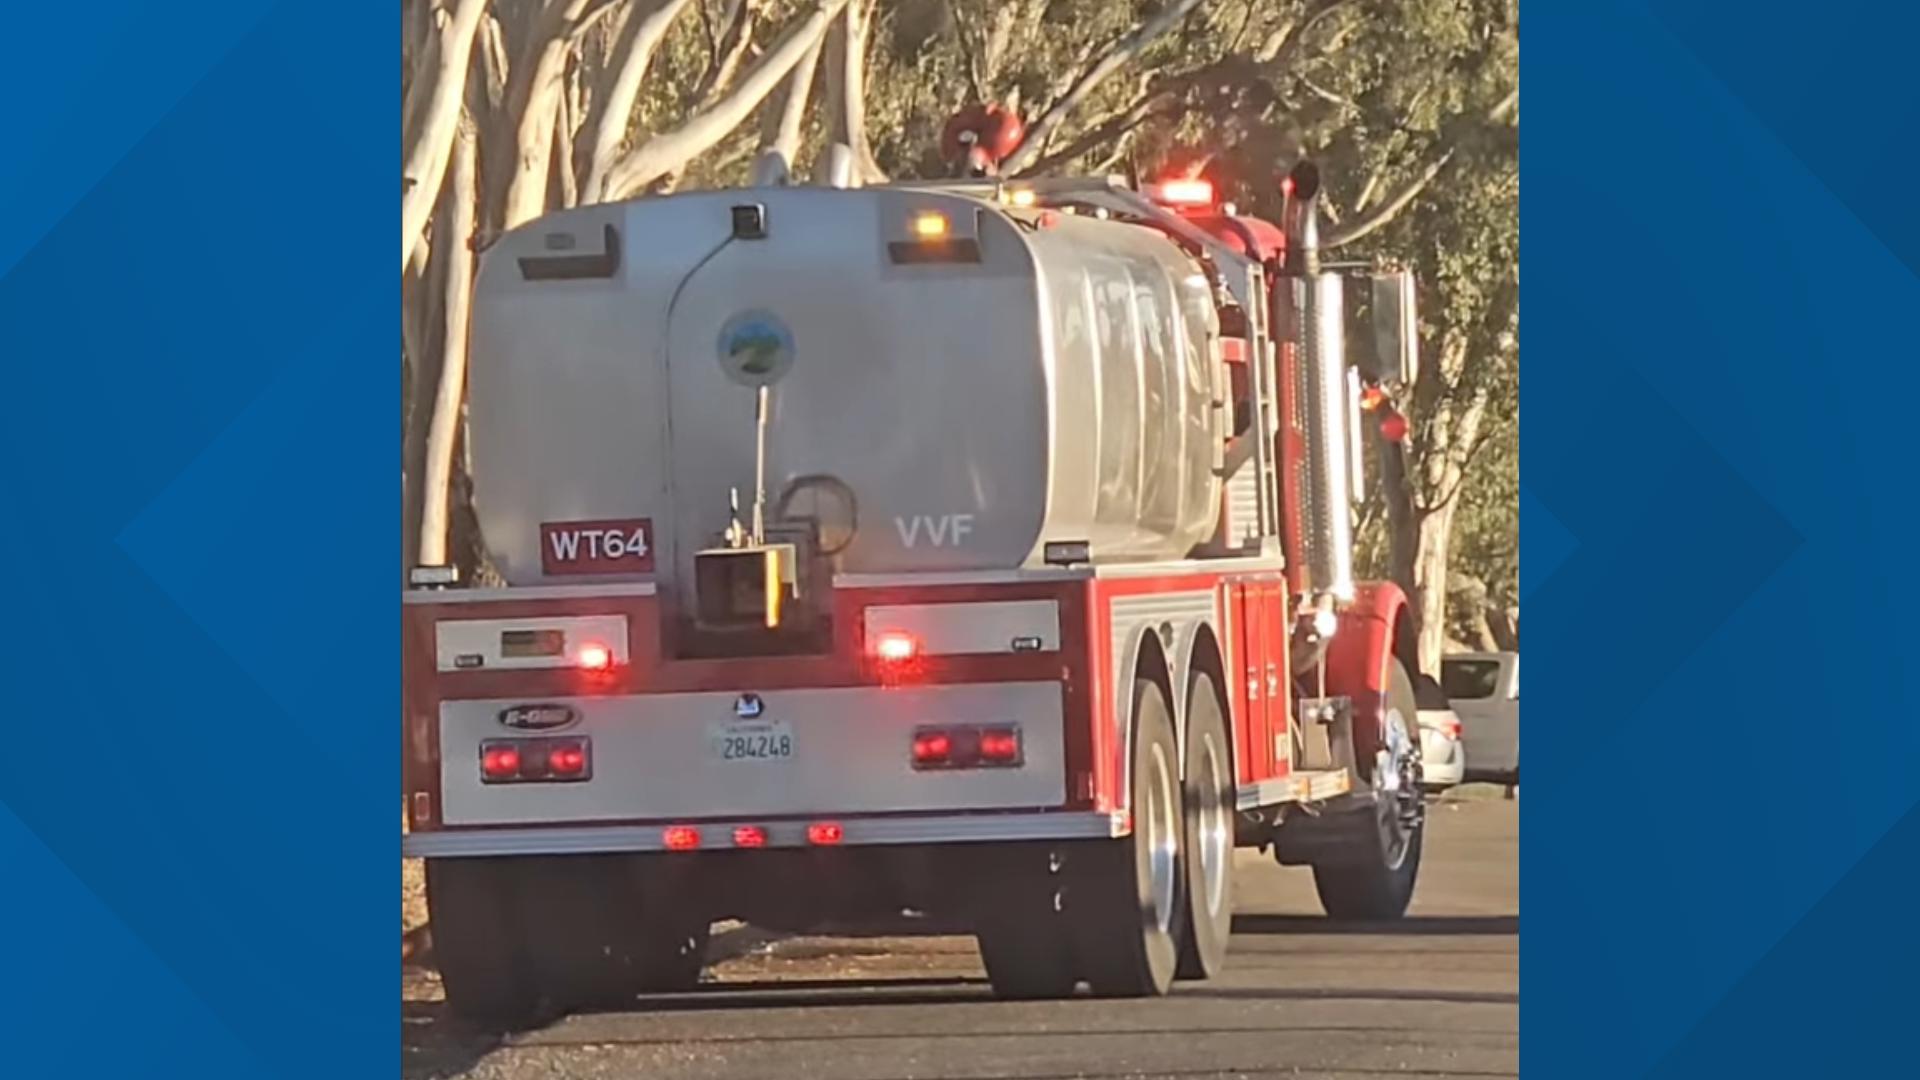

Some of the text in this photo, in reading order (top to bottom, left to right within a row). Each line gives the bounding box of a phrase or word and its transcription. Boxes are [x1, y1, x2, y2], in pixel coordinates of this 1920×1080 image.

[549, 527, 649, 561] WT64
[895, 513, 974, 548] VVF
[723, 735, 791, 759] 284248
